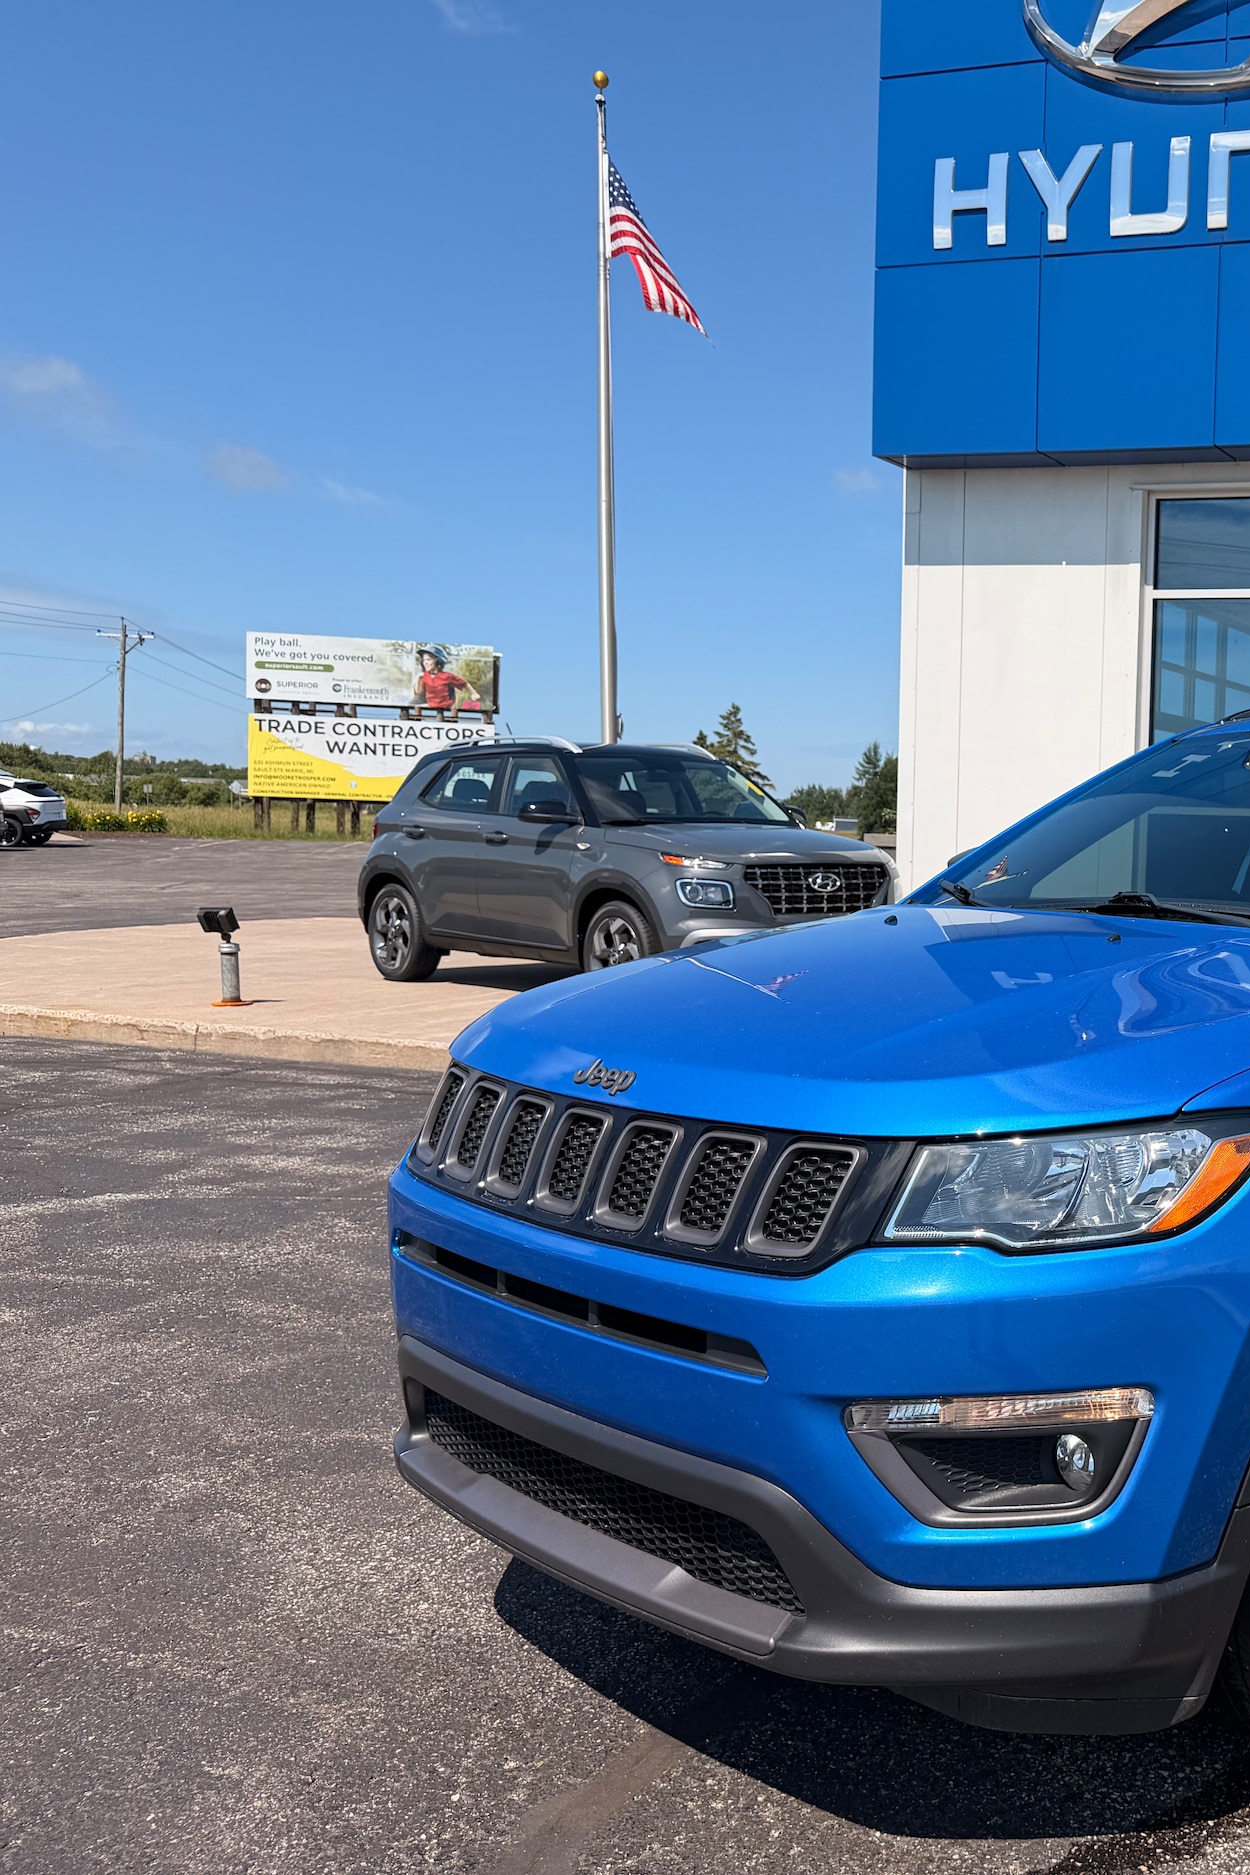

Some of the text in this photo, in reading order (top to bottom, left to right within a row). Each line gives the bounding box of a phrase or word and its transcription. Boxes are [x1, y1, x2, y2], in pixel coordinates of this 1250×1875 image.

[254, 636, 302, 648] Play ball.
[254, 648, 377, 664] We've got you covered.
[276, 680, 319, 689] SUPERIOR
[254, 718, 486, 741] TRADE CONTRACTORS
[325, 740, 418, 757] WANTED
[573, 1058, 636, 1096] Jeep
